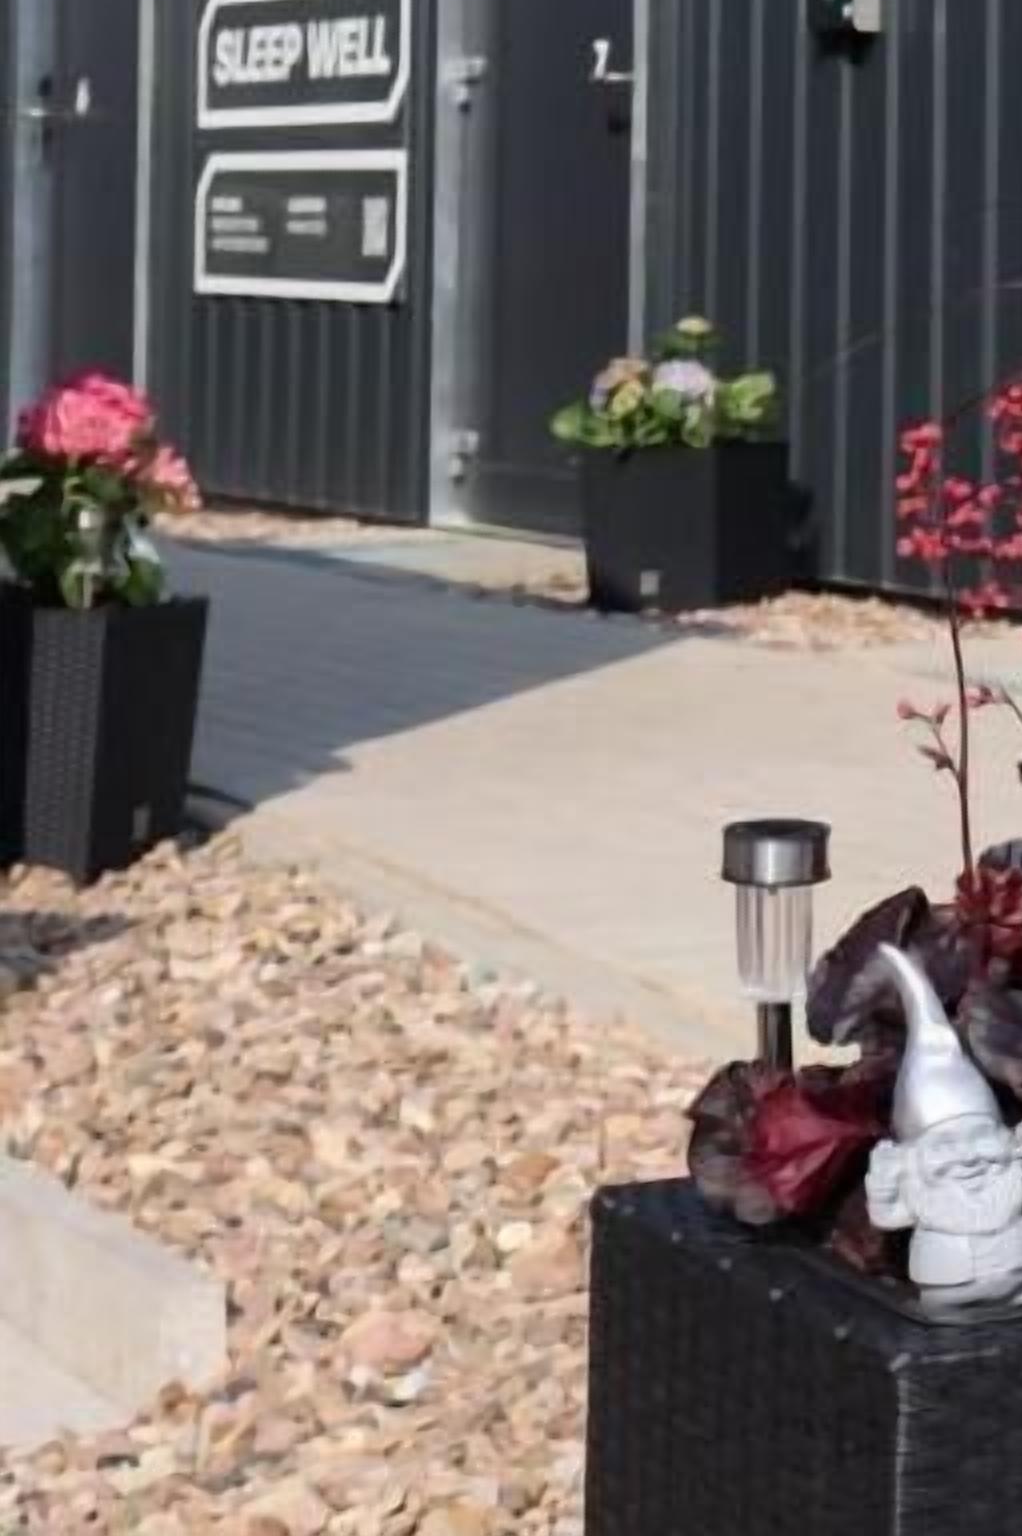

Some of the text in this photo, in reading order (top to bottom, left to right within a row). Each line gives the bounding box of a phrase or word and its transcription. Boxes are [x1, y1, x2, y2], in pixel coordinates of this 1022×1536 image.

[213, 15, 391, 86] SLEEP WELL
[593, 39, 609, 79] 7
